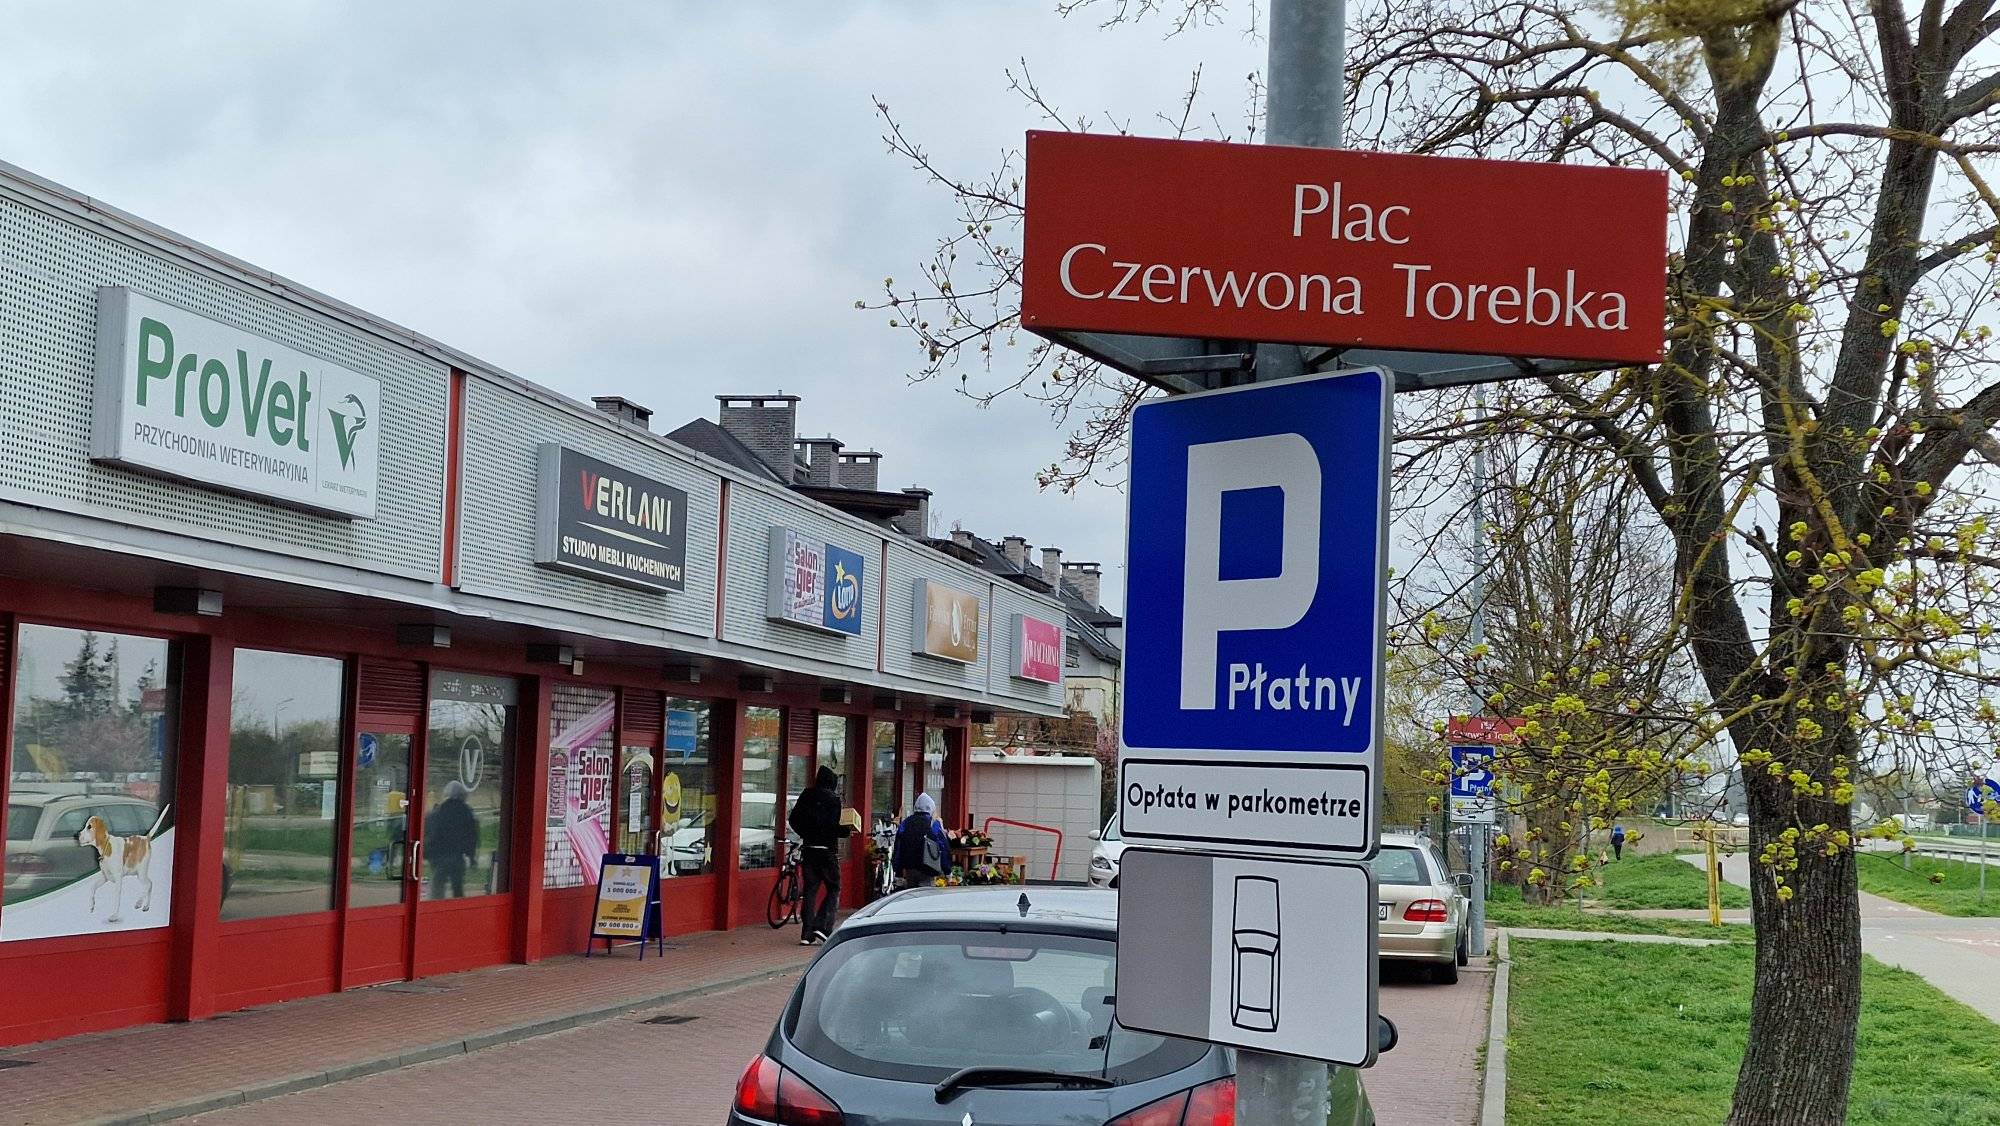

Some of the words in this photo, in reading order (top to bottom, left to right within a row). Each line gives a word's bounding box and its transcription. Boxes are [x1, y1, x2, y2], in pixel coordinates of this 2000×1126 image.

[1293, 182, 1411, 245] Plac
[1058, 243, 1364, 315] Czerwona
[1393, 263, 1630, 331] Torebka
[136, 316, 312, 452] ProVet
[134, 422, 217, 461] PRZYCHODNIA
[219, 445, 309, 484] WETERYNARYJNA
[581, 469, 672, 536] VERLANI
[562, 535, 597, 560] STUDIO
[598, 545, 625, 568] MEBLI
[626, 552, 681, 581] KUCHENNYCH
[795, 541, 818, 571] Salon
[796, 567, 817, 598] gier
[1180, 432, 1322, 710] P
[1229, 663, 1361, 726] Płatny
[578, 751, 610, 776] Salon
[579, 778, 608, 810] gier
[1127, 782, 1197, 814] Opłata
[1205, 790, 1220, 809] w
[1228, 788, 1361, 818] parkometrze
